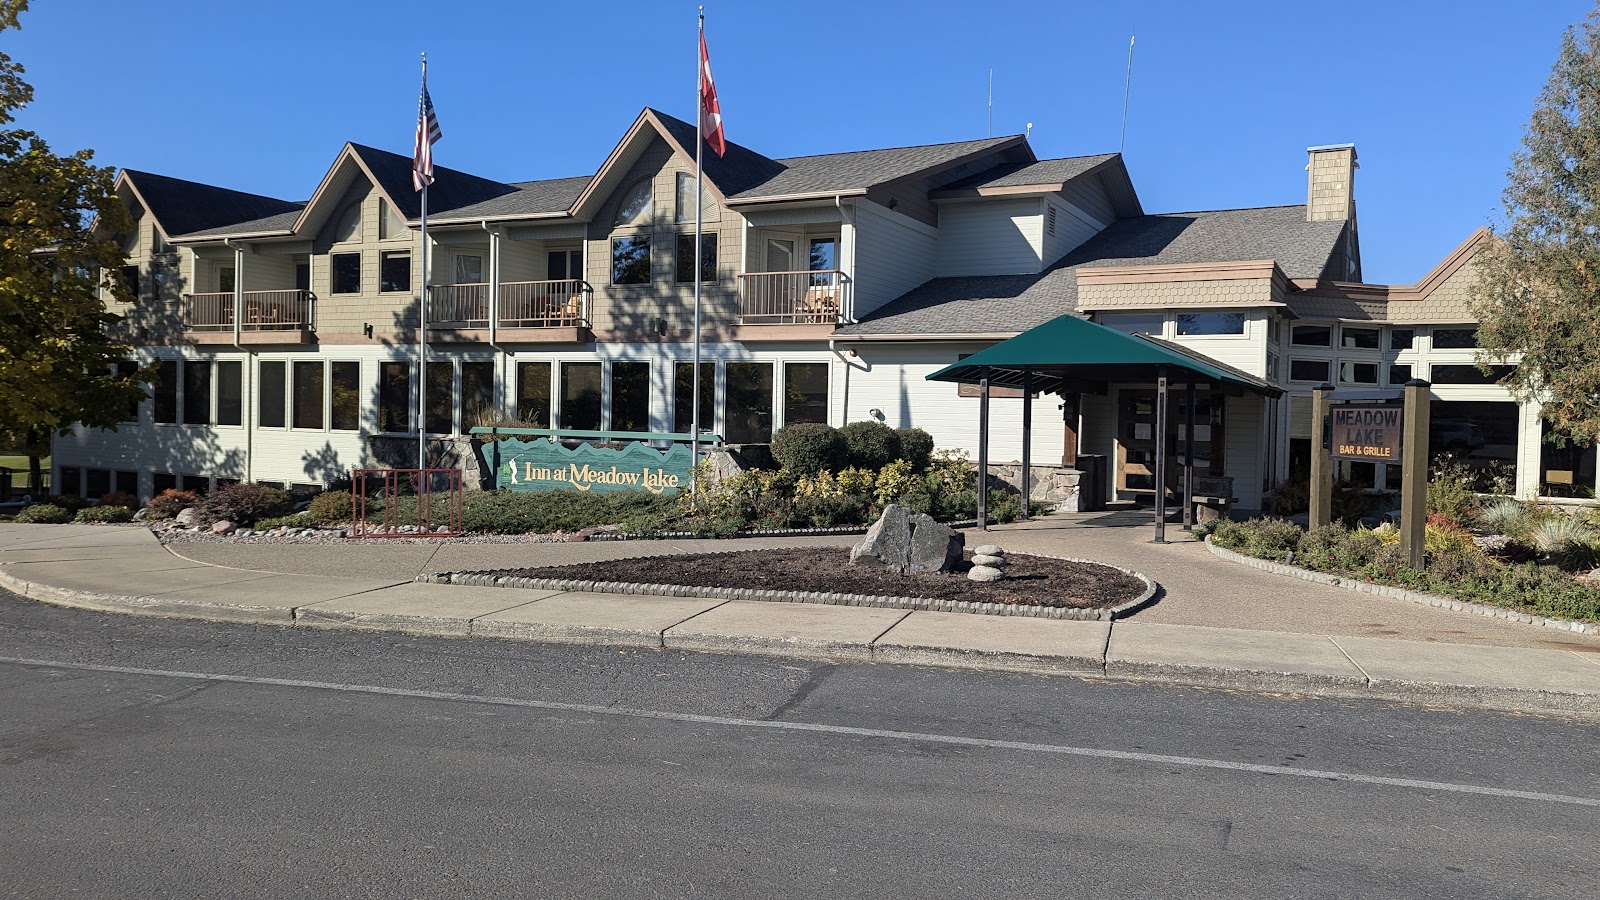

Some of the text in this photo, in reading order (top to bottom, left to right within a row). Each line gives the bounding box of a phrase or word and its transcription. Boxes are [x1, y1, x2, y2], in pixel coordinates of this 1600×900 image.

[1335, 410, 1398, 427] MEADOW
[1346, 428, 1384, 446] LAKE
[1339, 445, 1391, 457] BAR & GRILLE
[524, 461, 679, 495] Inn at Meadow Lake
